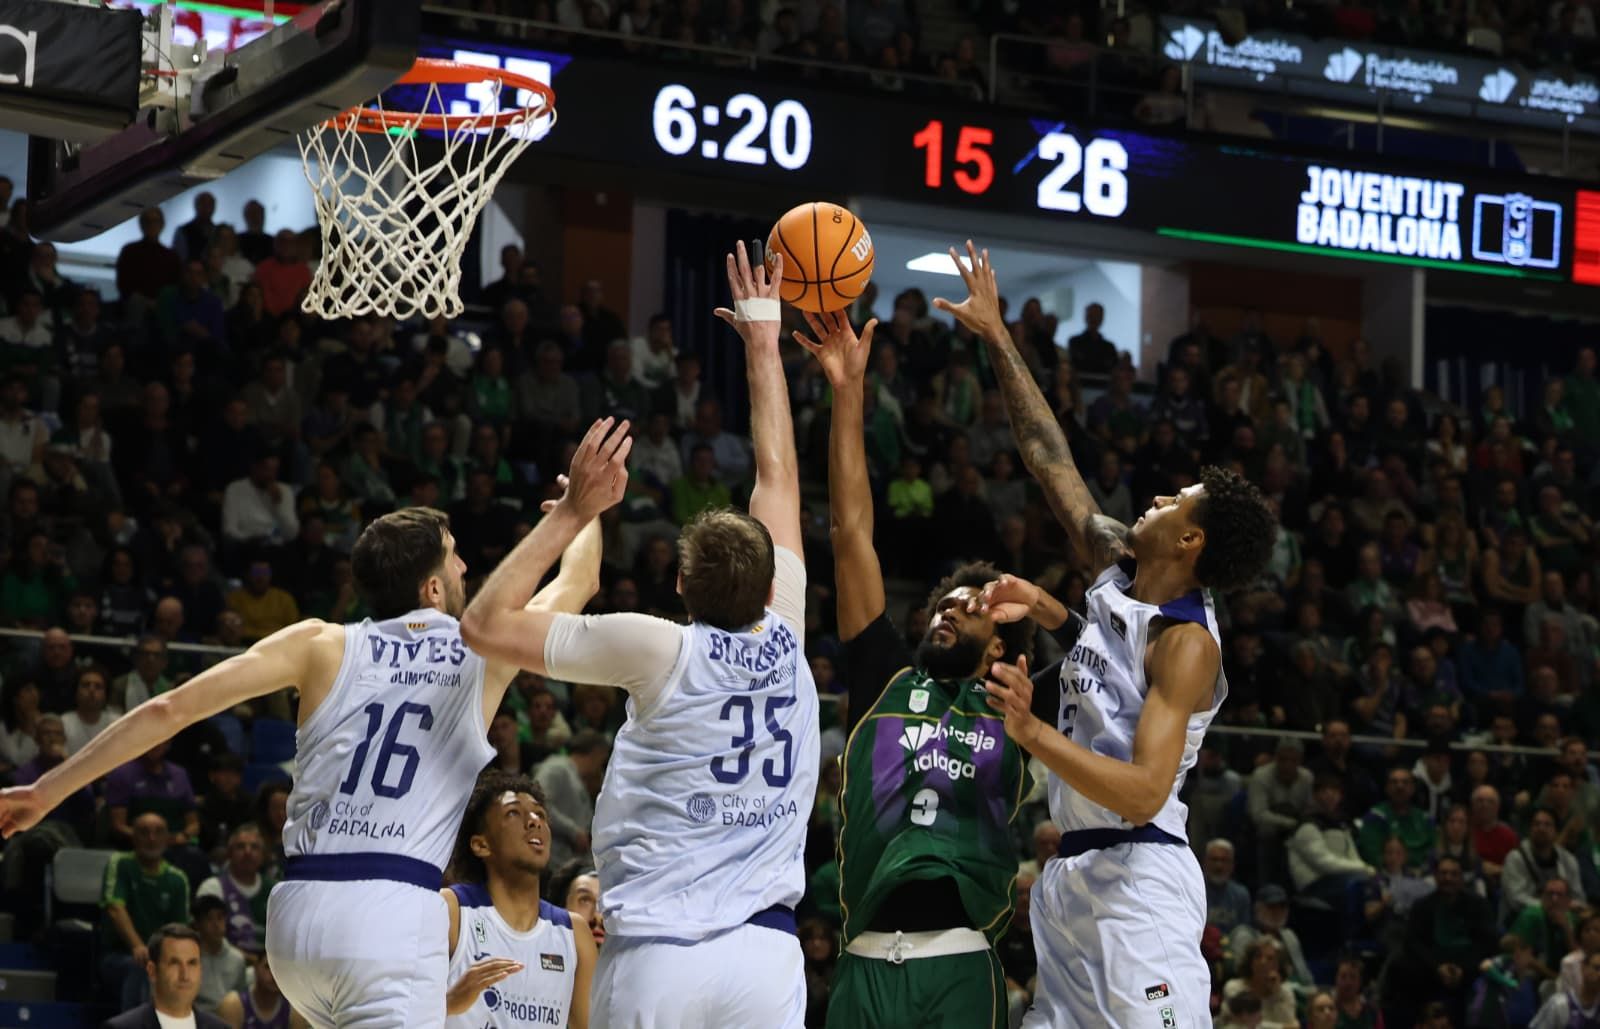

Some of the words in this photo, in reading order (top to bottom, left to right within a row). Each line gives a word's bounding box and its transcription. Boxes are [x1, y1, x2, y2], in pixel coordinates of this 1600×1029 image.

[653, 84, 812, 170] 6:20
[913, 119, 995, 195] 15
[1037, 132, 1129, 218] 26
[1300, 165, 1465, 222] JOVENTUT
[1296, 203, 1462, 261] BADALONA
[368, 634, 467, 668] VIVES
[1066, 645, 1108, 677] BITAS
[339, 701, 434, 799] 16
[710, 695, 797, 788] 35
[335, 801, 358, 818] Cty
[722, 793, 748, 811] City
[753, 795, 766, 809] of
[910, 788, 939, 826] 3
[504, 1000, 561, 1026] PROBITAS
